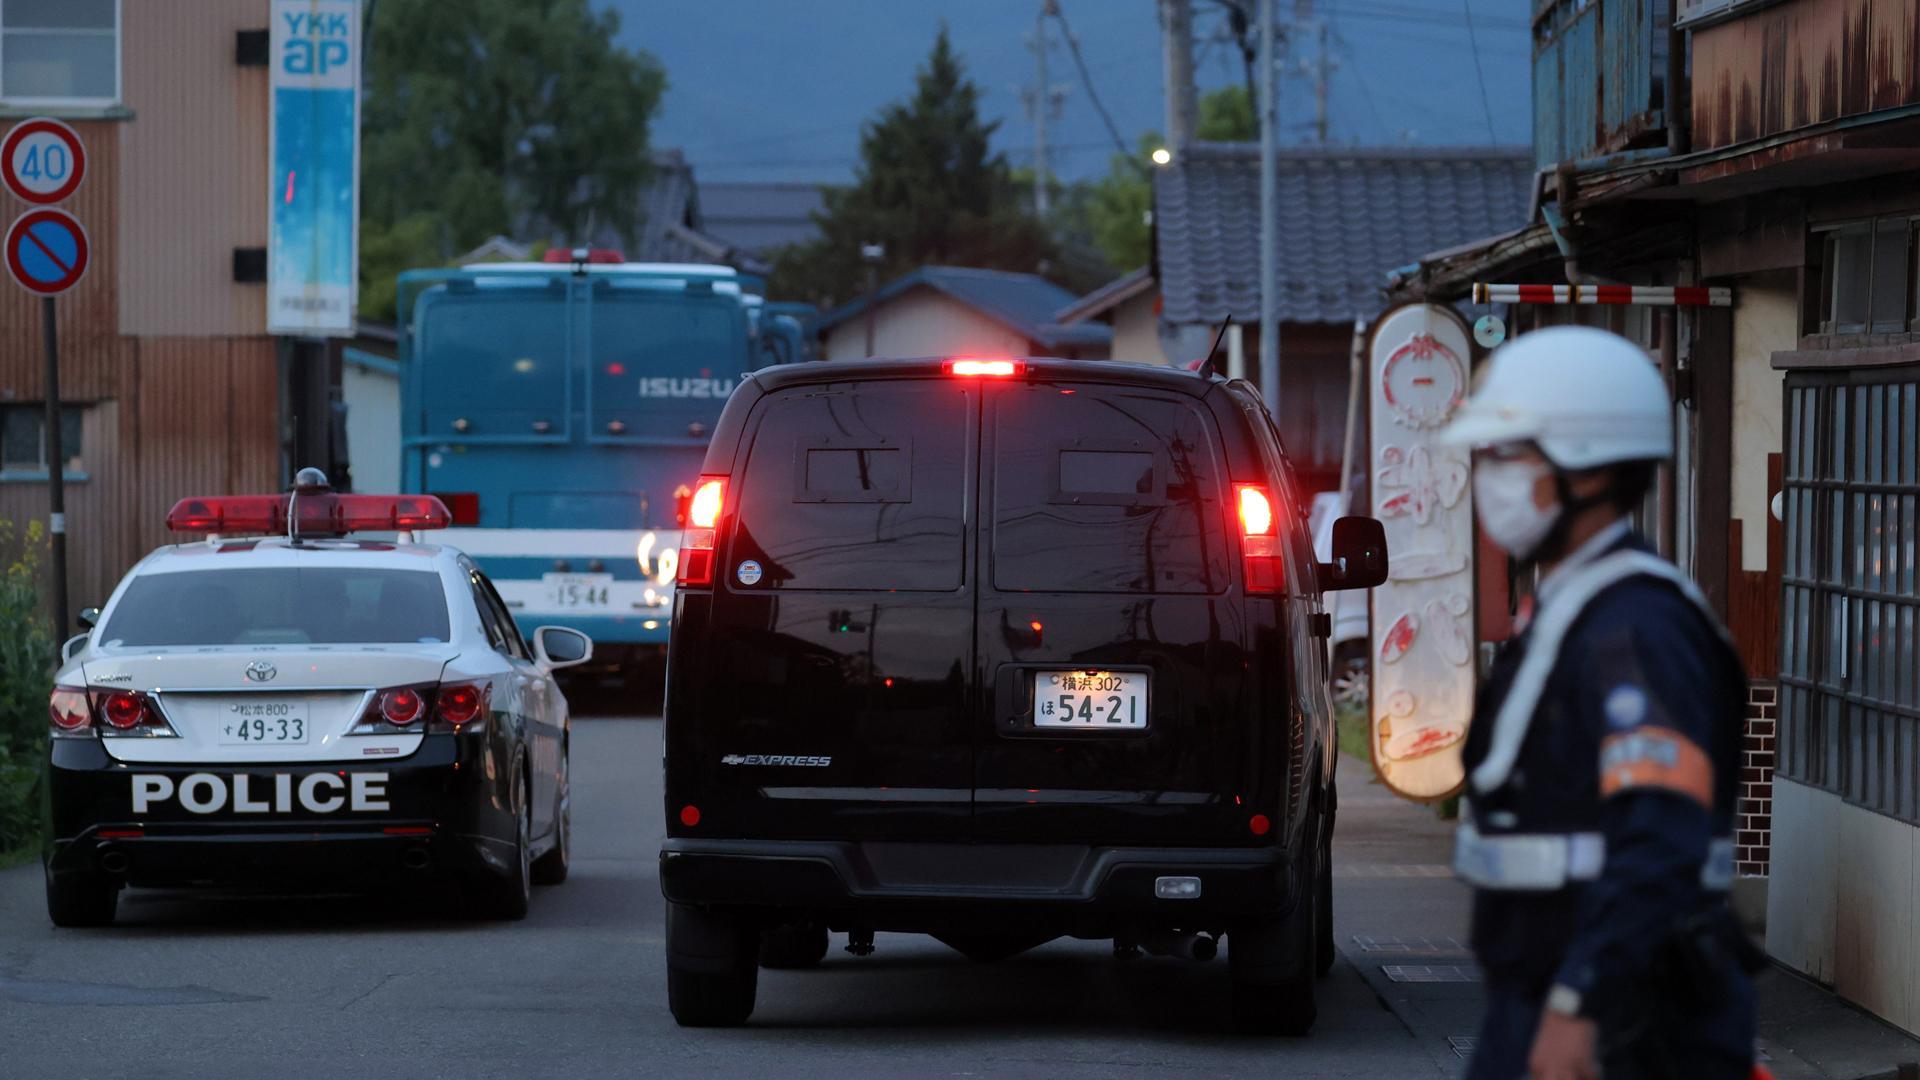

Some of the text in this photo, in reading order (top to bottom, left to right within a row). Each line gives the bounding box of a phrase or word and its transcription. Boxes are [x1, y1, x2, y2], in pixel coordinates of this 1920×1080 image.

[283, 12, 348, 36] YKK
[283, 39, 349, 75] ap
[22, 143, 66, 180] 40
[640, 378, 733, 398] ISUZU
[1041, 694, 1136, 724] ほ 54-21
[238, 718, 304, 741] 49-33
[743, 755, 832, 767] EXPRESS
[131, 772, 390, 814] POLICE
